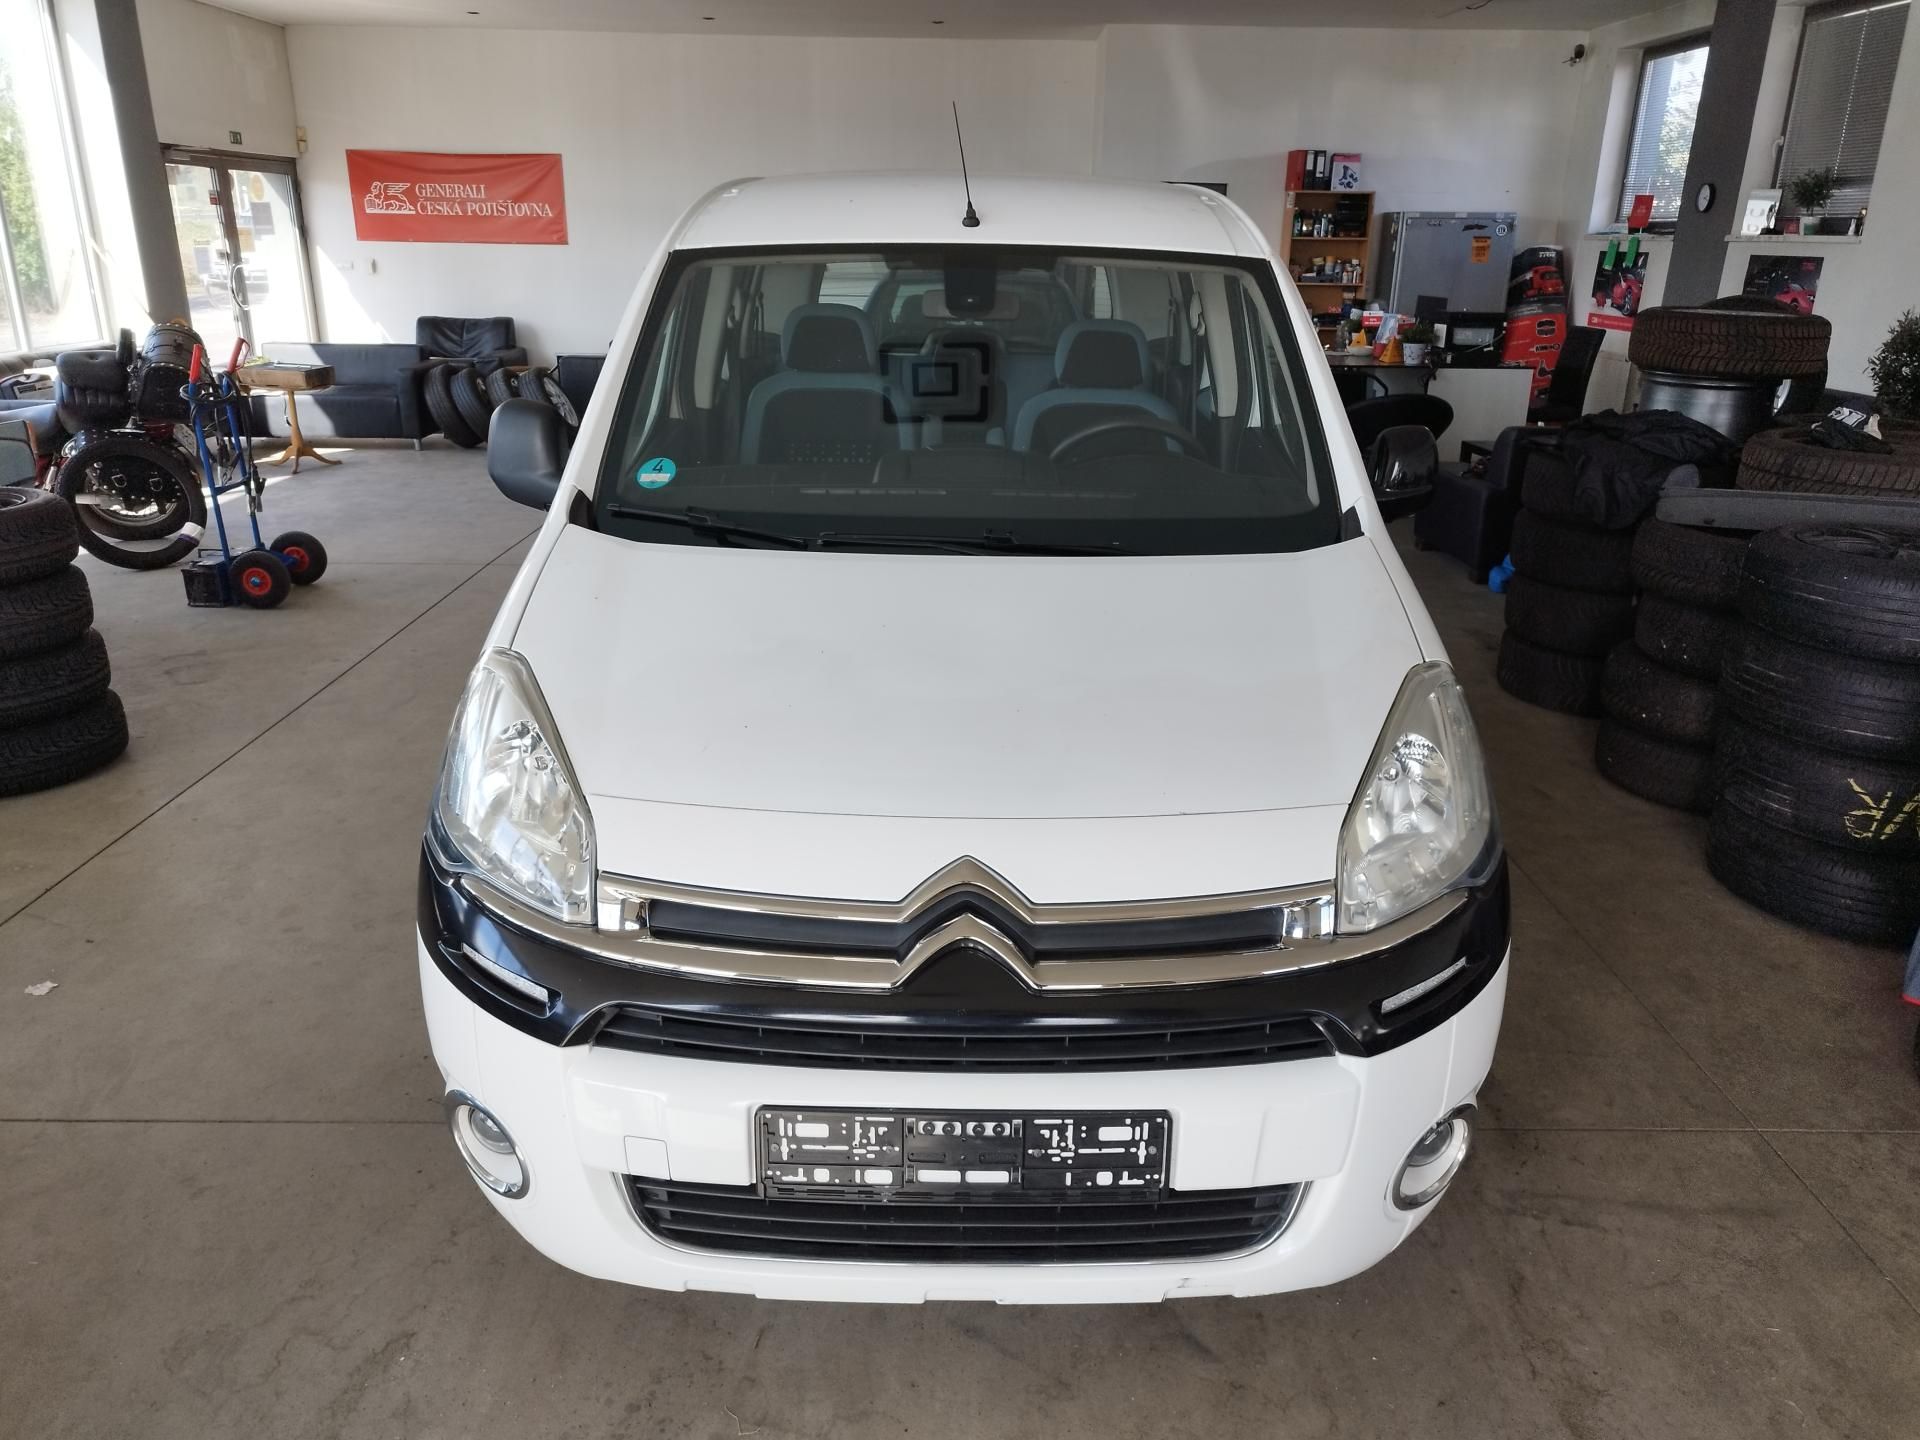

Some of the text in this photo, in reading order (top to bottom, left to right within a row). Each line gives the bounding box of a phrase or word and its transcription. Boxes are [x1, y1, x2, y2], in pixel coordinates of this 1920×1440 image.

[415, 183, 485, 198] GENERALI
[417, 198, 553, 217] ČESKÁ POJIŠŤOVNA
[652, 458, 665, 473] 4
